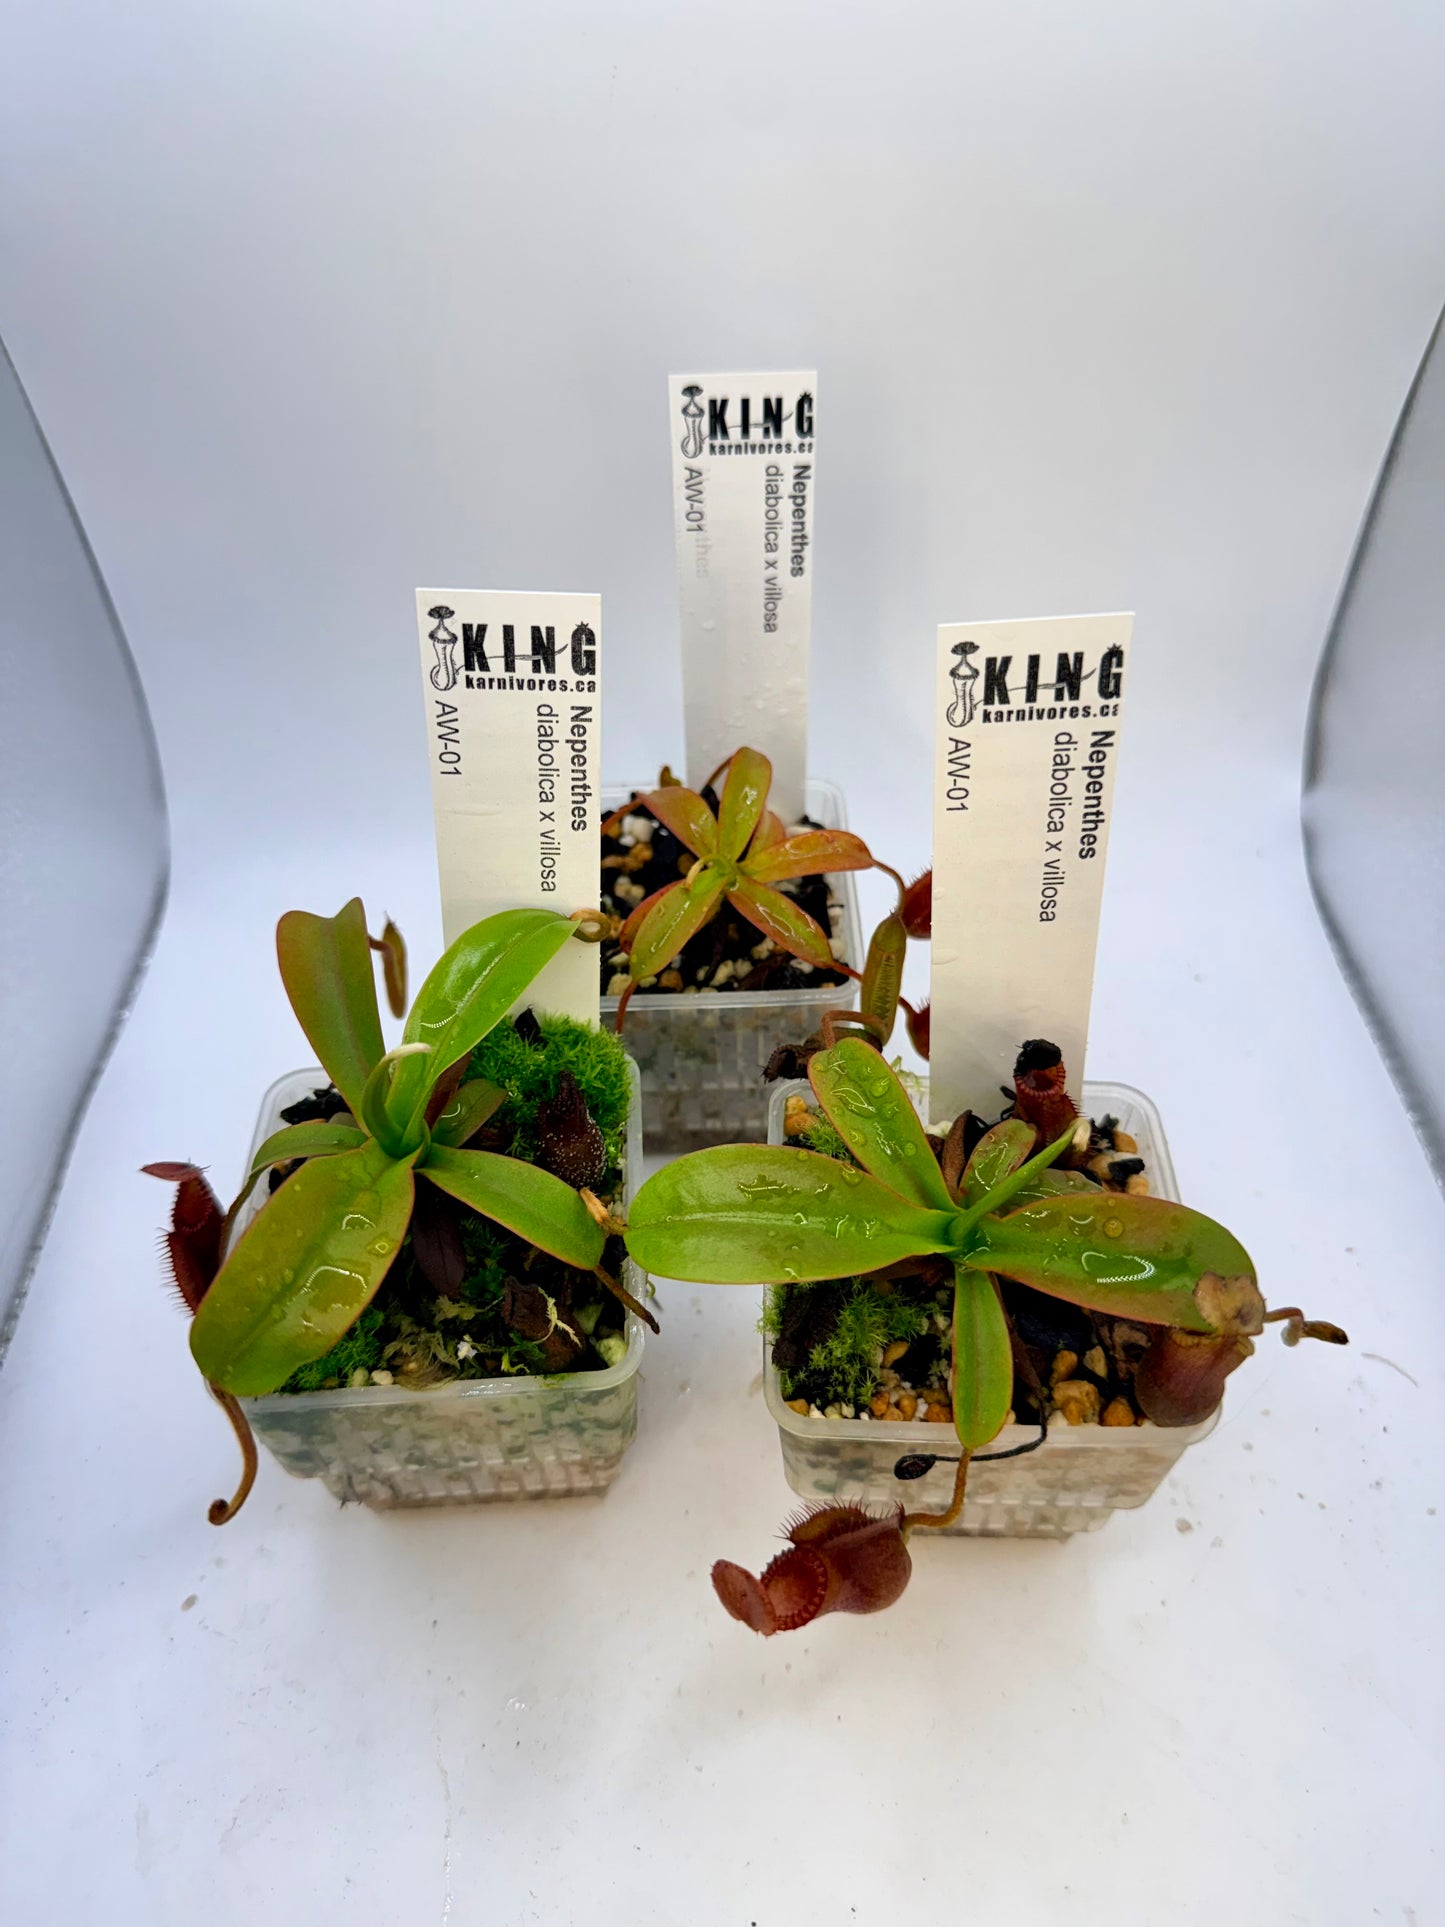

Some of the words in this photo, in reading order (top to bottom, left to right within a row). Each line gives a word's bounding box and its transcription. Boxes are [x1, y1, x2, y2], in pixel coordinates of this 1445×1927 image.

[708, 395, 814, 440] KING
[684, 466, 705, 533] AW-01
[764, 464, 784, 554] diabolica
[788, 464, 812, 578] Nepenthes
[764, 559, 778, 571] x
[763, 576, 783, 633] villosa
[462, 623, 596, 676] KING
[983, 645, 1124, 706] KING
[465, 675, 596, 693] karnivores.ca
[435, 700, 462, 775] AW-01
[537, 703, 561, 804] diabolica
[565, 705, 593, 832] Nepenthes
[946, 736, 972, 812] AW-01
[1046, 732, 1078, 833] diabolica
[1079, 730, 1115, 860] Nepenthes
[540, 811, 555, 823] x
[1044, 840, 1063, 852] x
[540, 829, 561, 892] villosa
[1039, 858, 1065, 923] villosa
